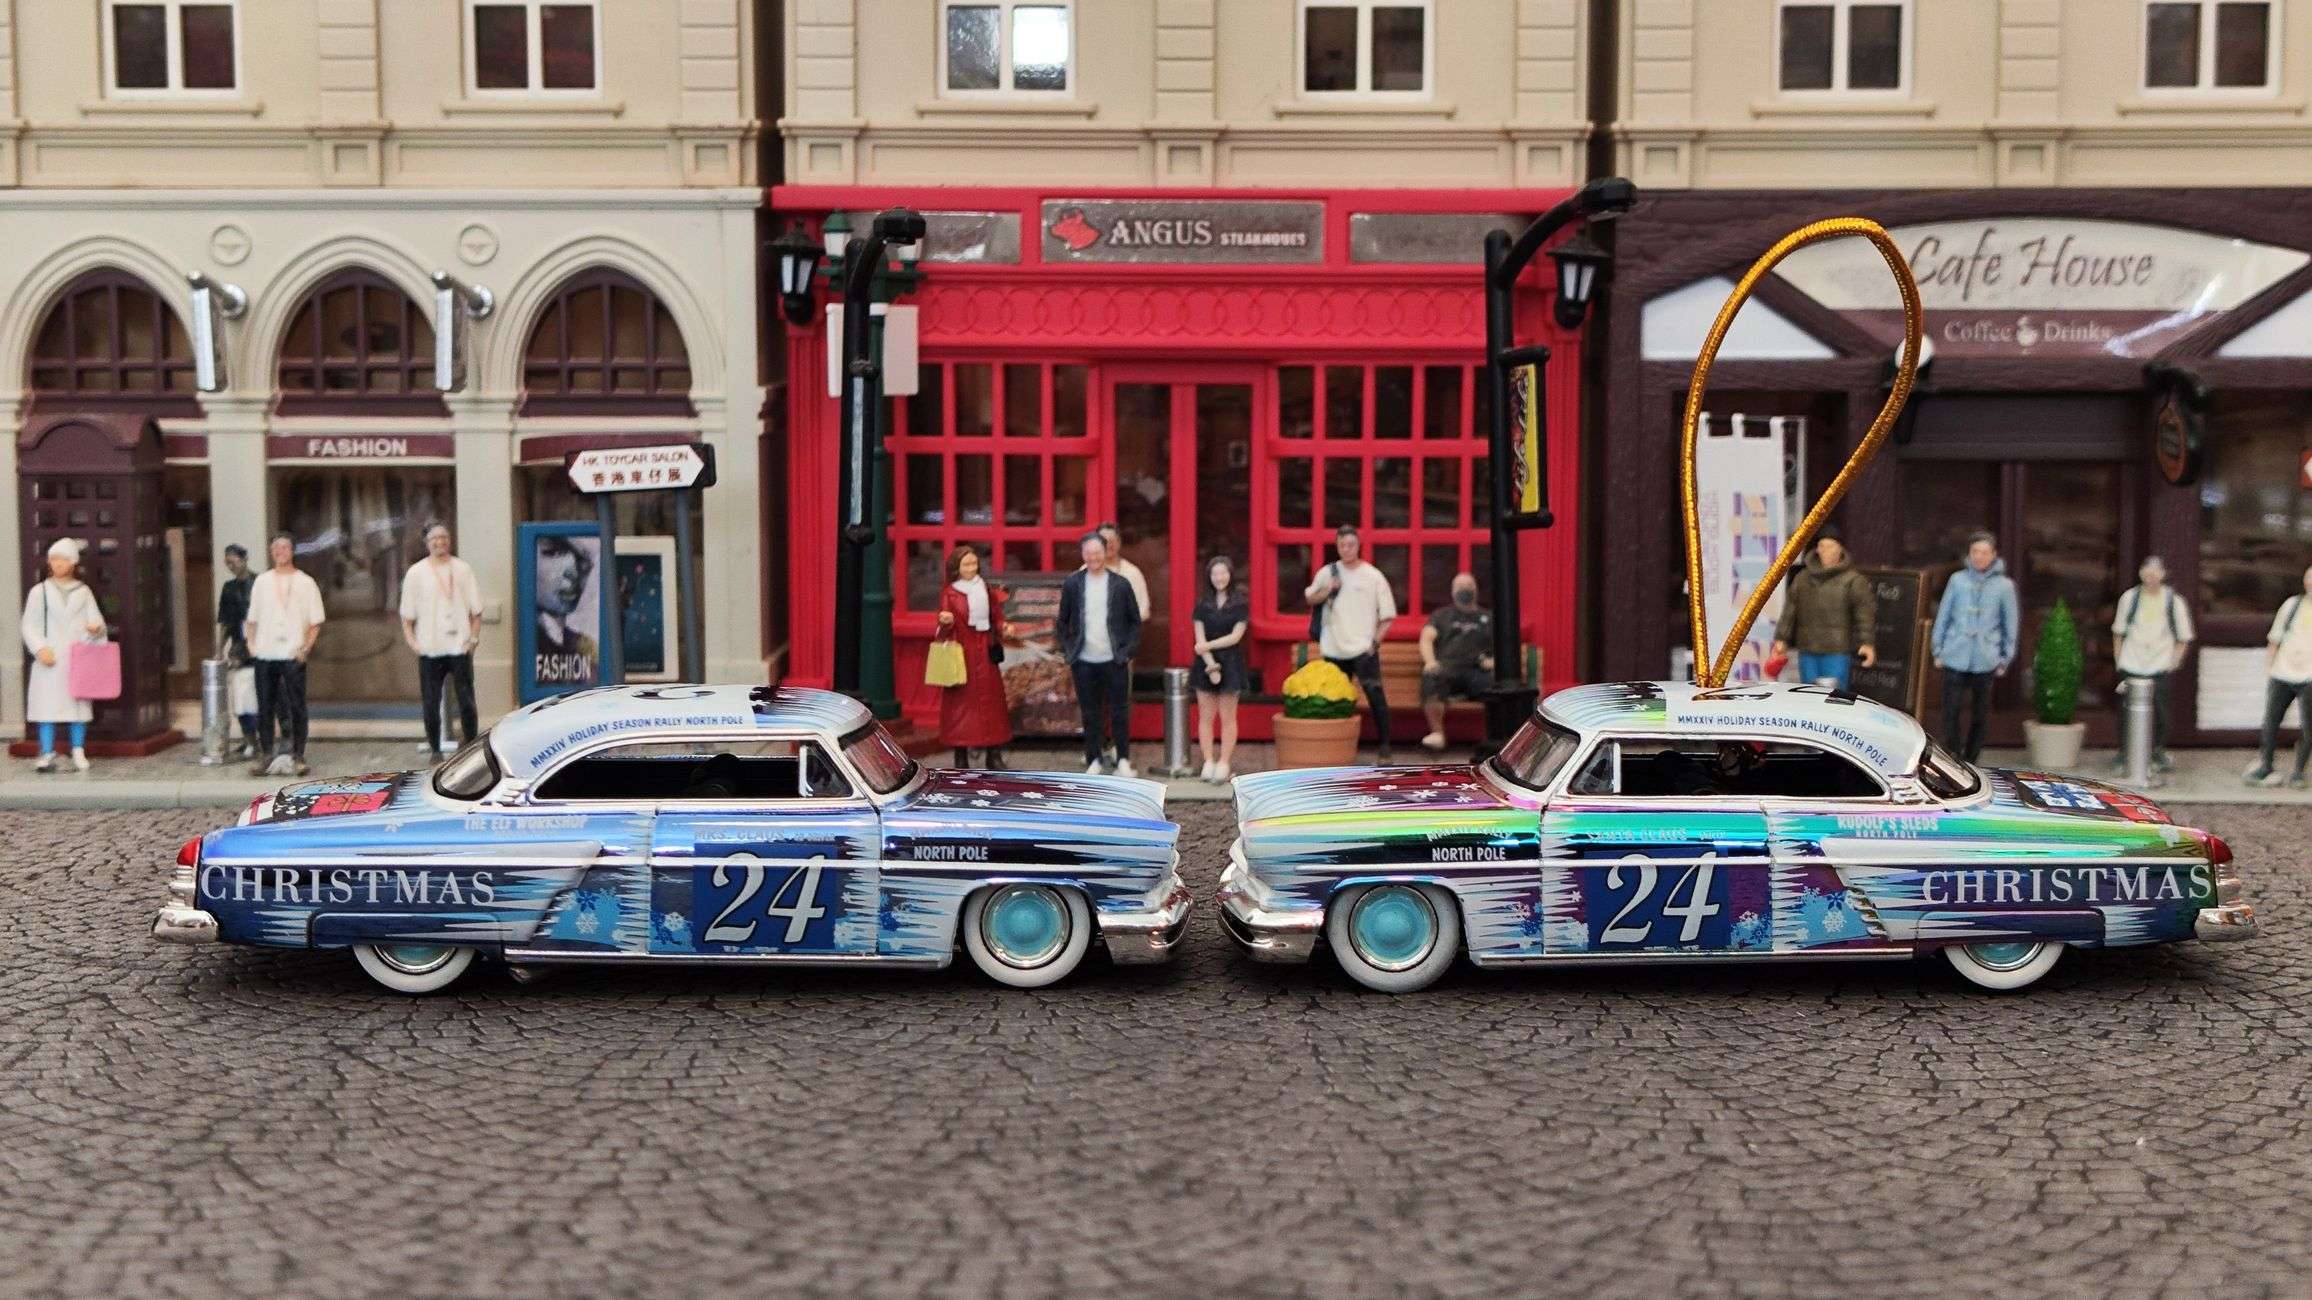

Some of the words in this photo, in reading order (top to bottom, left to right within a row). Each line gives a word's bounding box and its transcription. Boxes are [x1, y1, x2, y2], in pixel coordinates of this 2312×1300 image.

[1109, 219, 1213, 245] ANGUS
[1909, 227, 2002, 301] Cafe
[2019, 234, 2154, 287] House
[1944, 319, 2013, 342] Coffee
[307, 438, 408, 457] FASHION
[651, 450, 690, 463] SALON
[536, 654, 592, 681] FASHION
[530, 740, 566, 768] MMXXIV
[568, 722, 608, 744] HOLIDAY
[612, 717, 651, 731] SEASON
[654, 716, 681, 727] RALLY
[686, 716, 718, 726] NORTH
[721, 715, 744, 725] POLE
[1678, 715, 1713, 725] MMXXIV
[1717, 716, 1757, 726] HOLIDAY
[1759, 717, 1797, 728] SEASON
[1801, 719, 1830, 734] RALLY
[1832, 727, 1865, 748] NORTH
[1865, 745, 1889, 767] POLE
[914, 846, 955, 860] NORTH
[959, 846, 988, 860] POLE
[1431, 847, 1473, 861] NORTH
[1477, 847, 1506, 860] POLE
[201, 865, 495, 906] CHRISTMAS
[704, 852, 826, 944] 24
[1600, 851, 1720, 944] 24
[1922, 865, 2212, 904] CHRISTMAS
